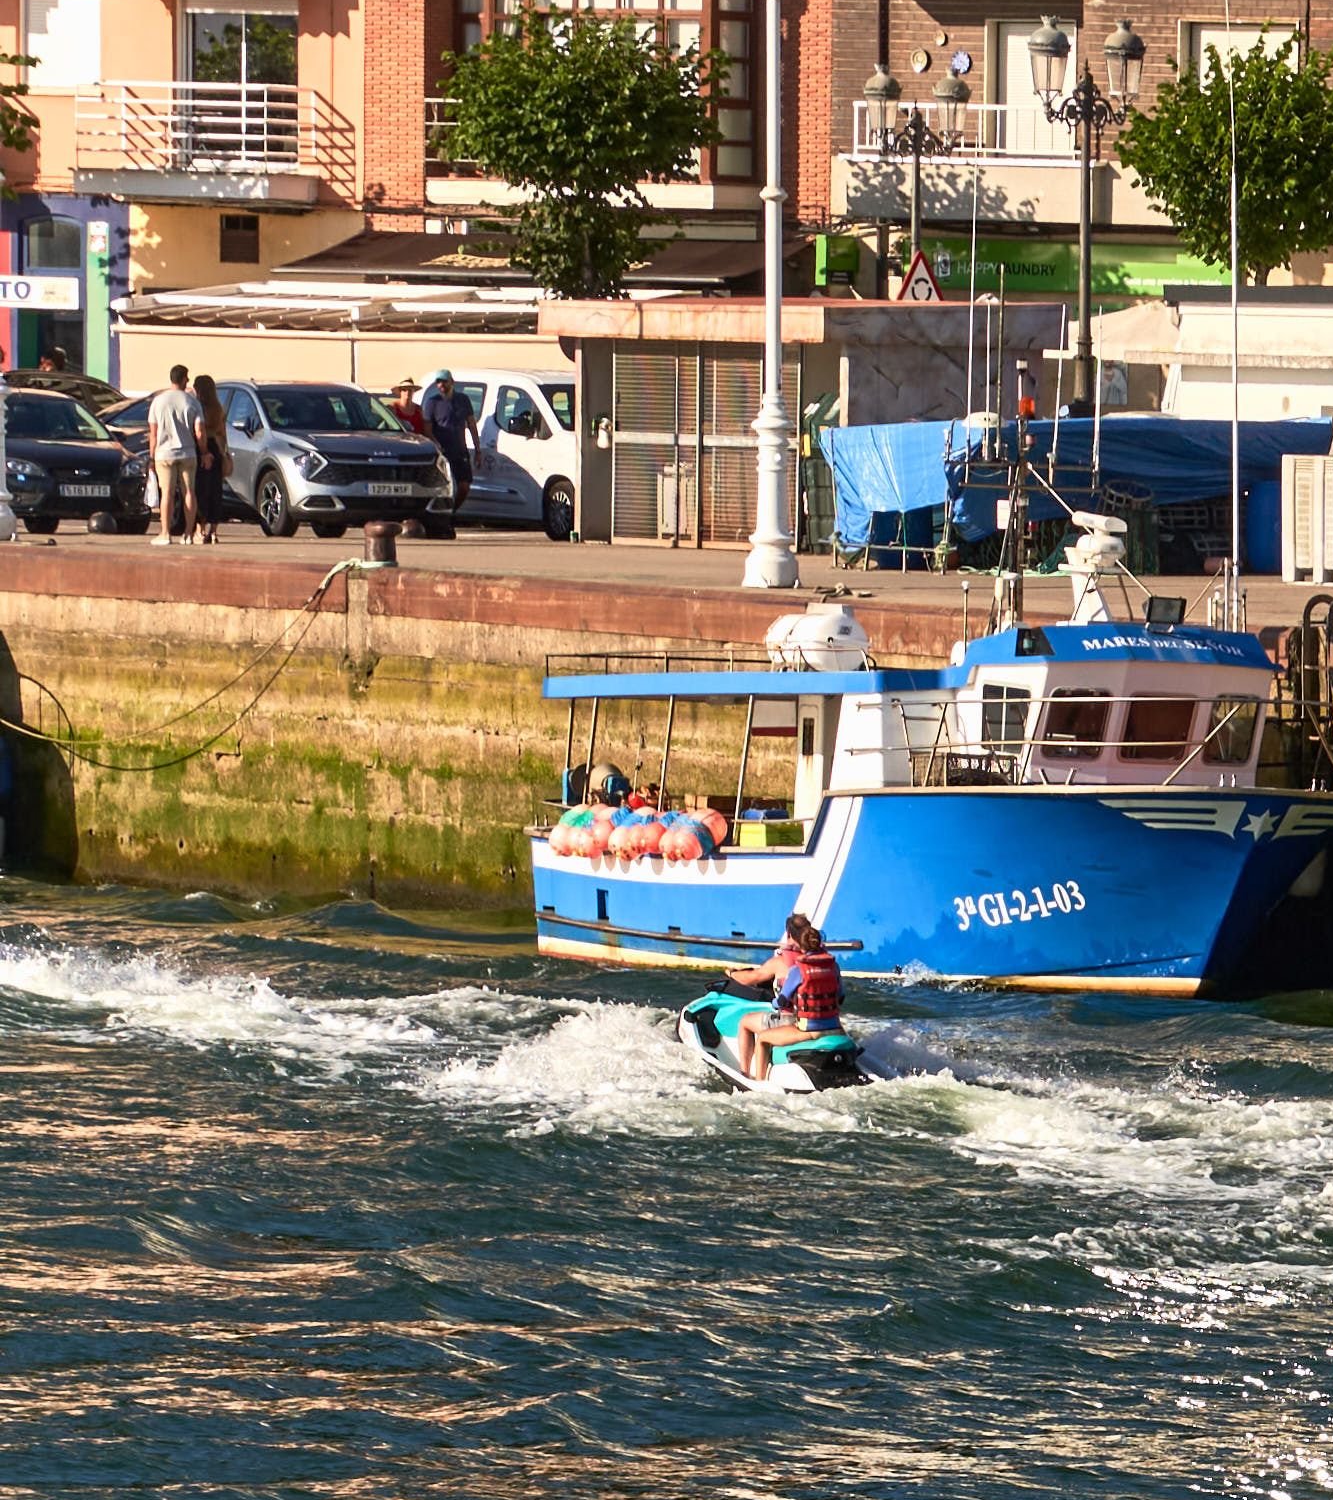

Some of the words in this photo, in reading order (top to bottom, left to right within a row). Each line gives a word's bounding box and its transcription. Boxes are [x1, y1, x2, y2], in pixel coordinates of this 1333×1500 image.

[1081, 636, 1150, 651] MARES
[1153, 639, 1182, 649] DEL
[1183, 638, 1246, 658] SEÑOR
